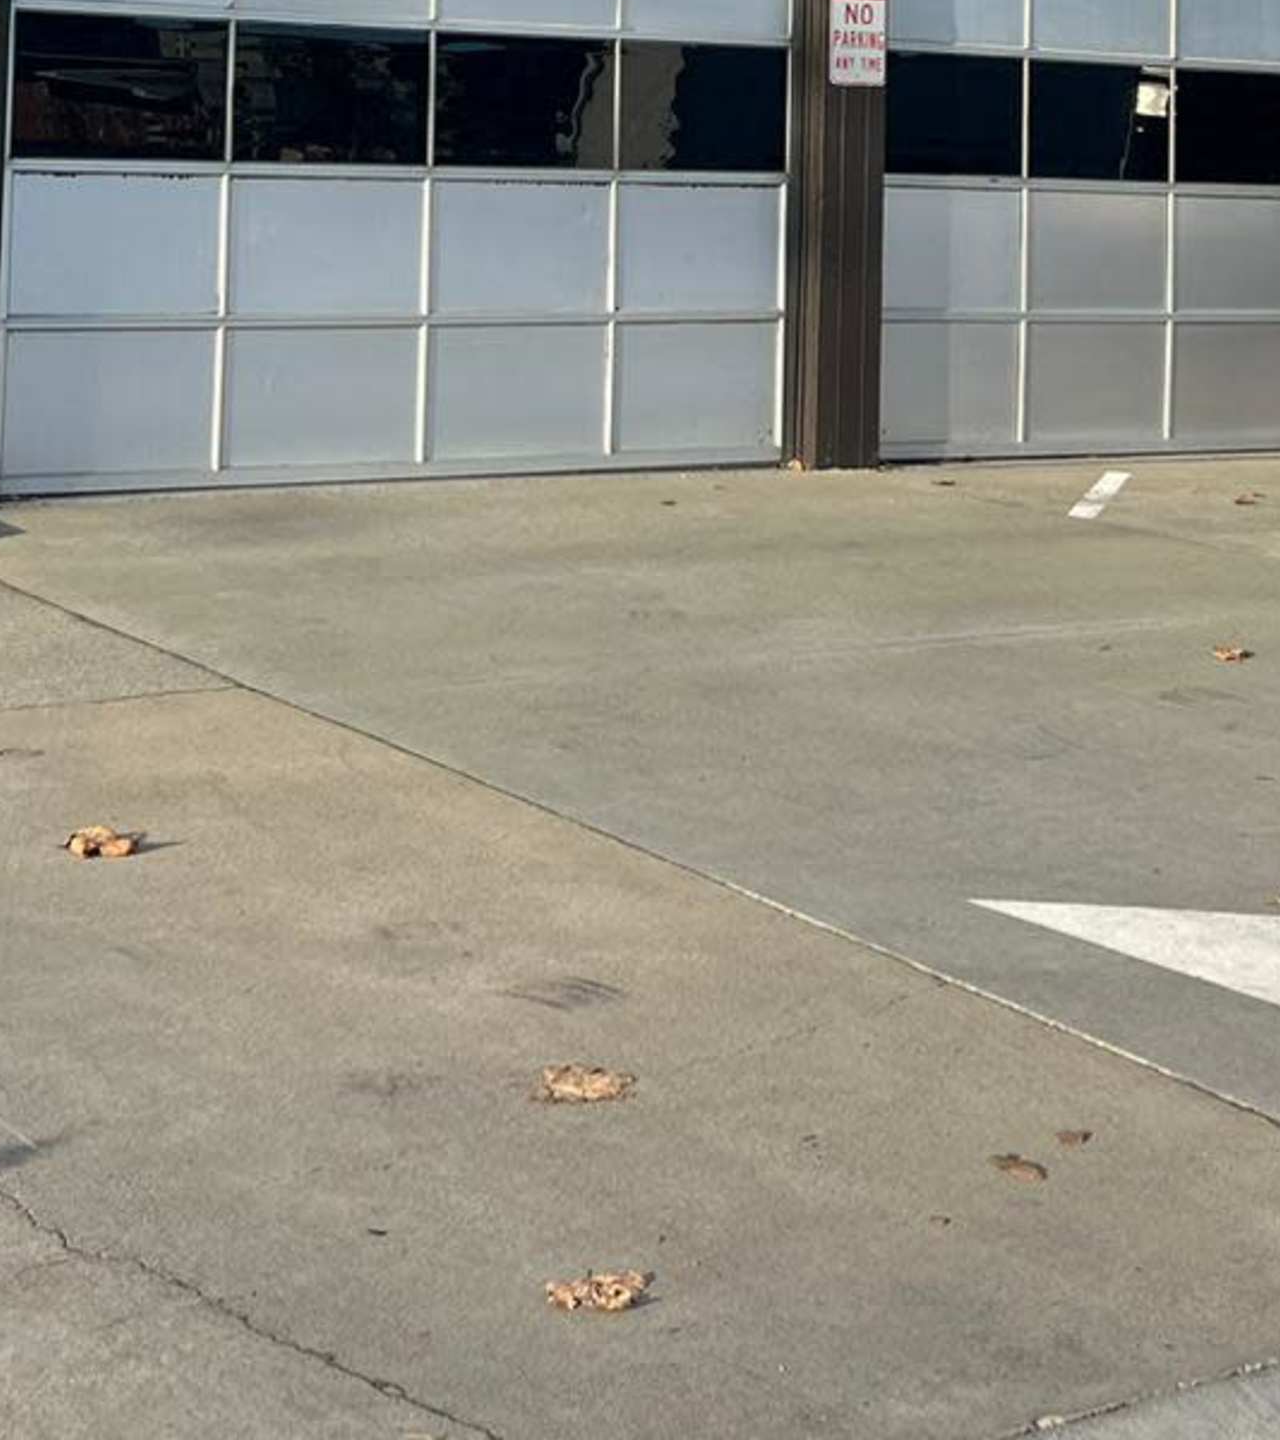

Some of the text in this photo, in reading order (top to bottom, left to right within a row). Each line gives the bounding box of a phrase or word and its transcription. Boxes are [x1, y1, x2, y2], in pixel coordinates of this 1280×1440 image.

[845, 4, 873, 24] NO
[833, 30, 884, 51] PARKING
[836, 56, 854, 69] ANY
